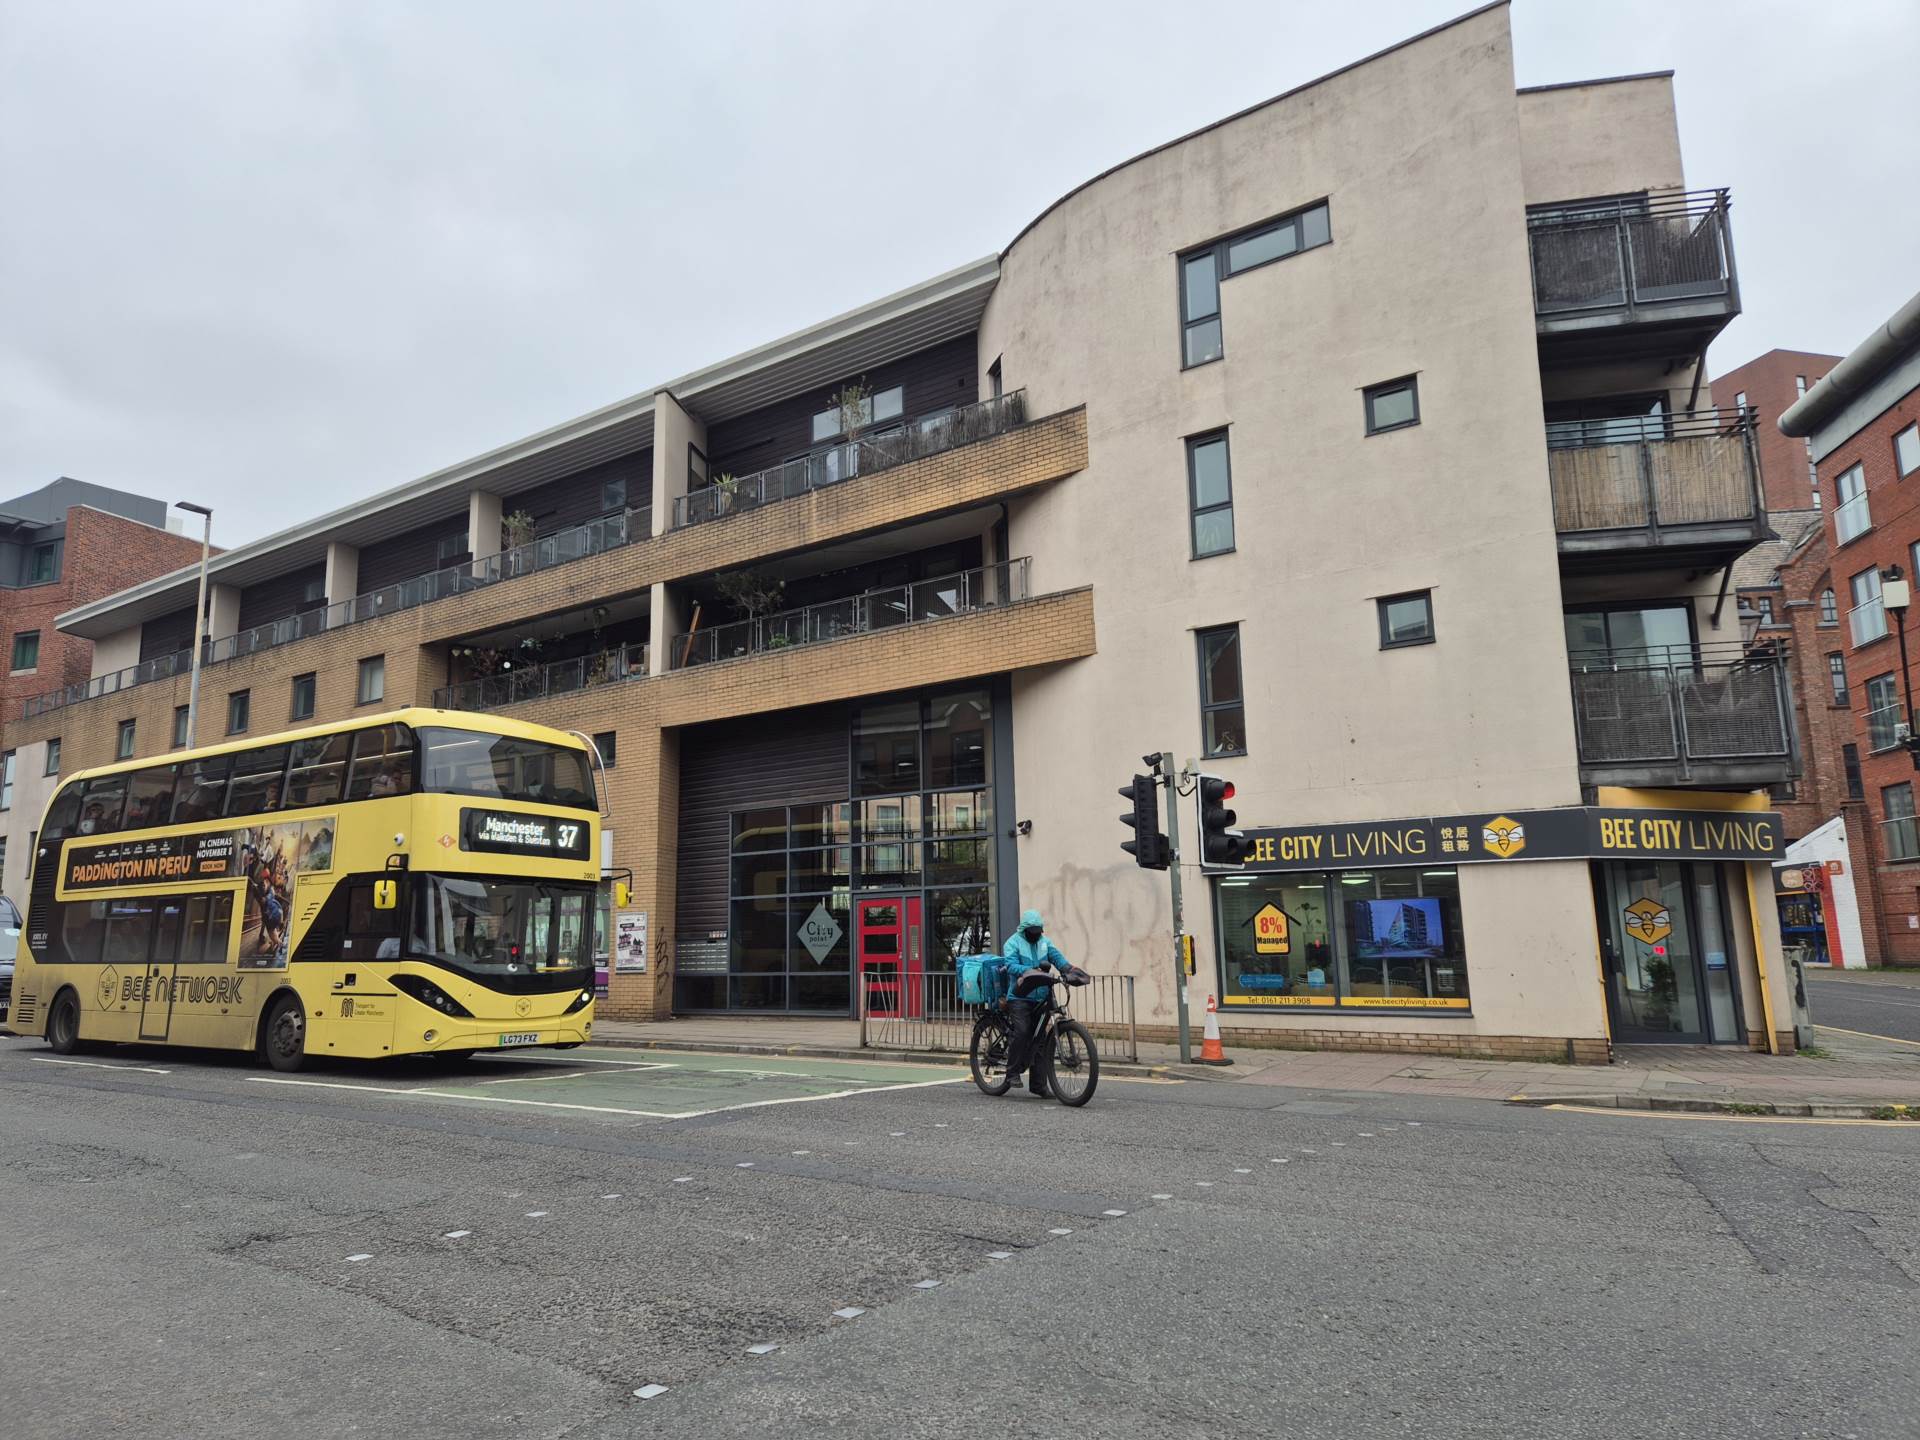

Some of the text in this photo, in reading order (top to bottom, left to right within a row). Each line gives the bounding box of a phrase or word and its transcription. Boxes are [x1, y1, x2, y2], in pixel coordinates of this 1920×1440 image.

[486, 817, 545, 836] Manchester
[1600, 818, 1774, 851] BEE CITY LIVING
[199, 837, 233, 849] IN CINEMAS
[479, 831, 490, 840] via
[557, 825, 579, 848] 37
[196, 848, 228, 859] NOVEMBER
[1244, 829, 1426, 862] EE CITY LIVING
[143, 858, 157, 877] IN
[158, 855, 192, 876] PERU
[806, 921, 834, 938] City
[1260, 916, 1283, 934] 8%
[1256, 936, 1289, 946] Managed
[121, 975, 153, 1002] BEE
[1248, 996, 1260, 1004] Tel:
[1261, 996, 1277, 1005] 0161
[1293, 997, 1311, 1005] 3908
[1363, 998, 1448, 1008] www.beecityliving.co.uk
[503, 1034, 538, 1044] LG73 FXZ
